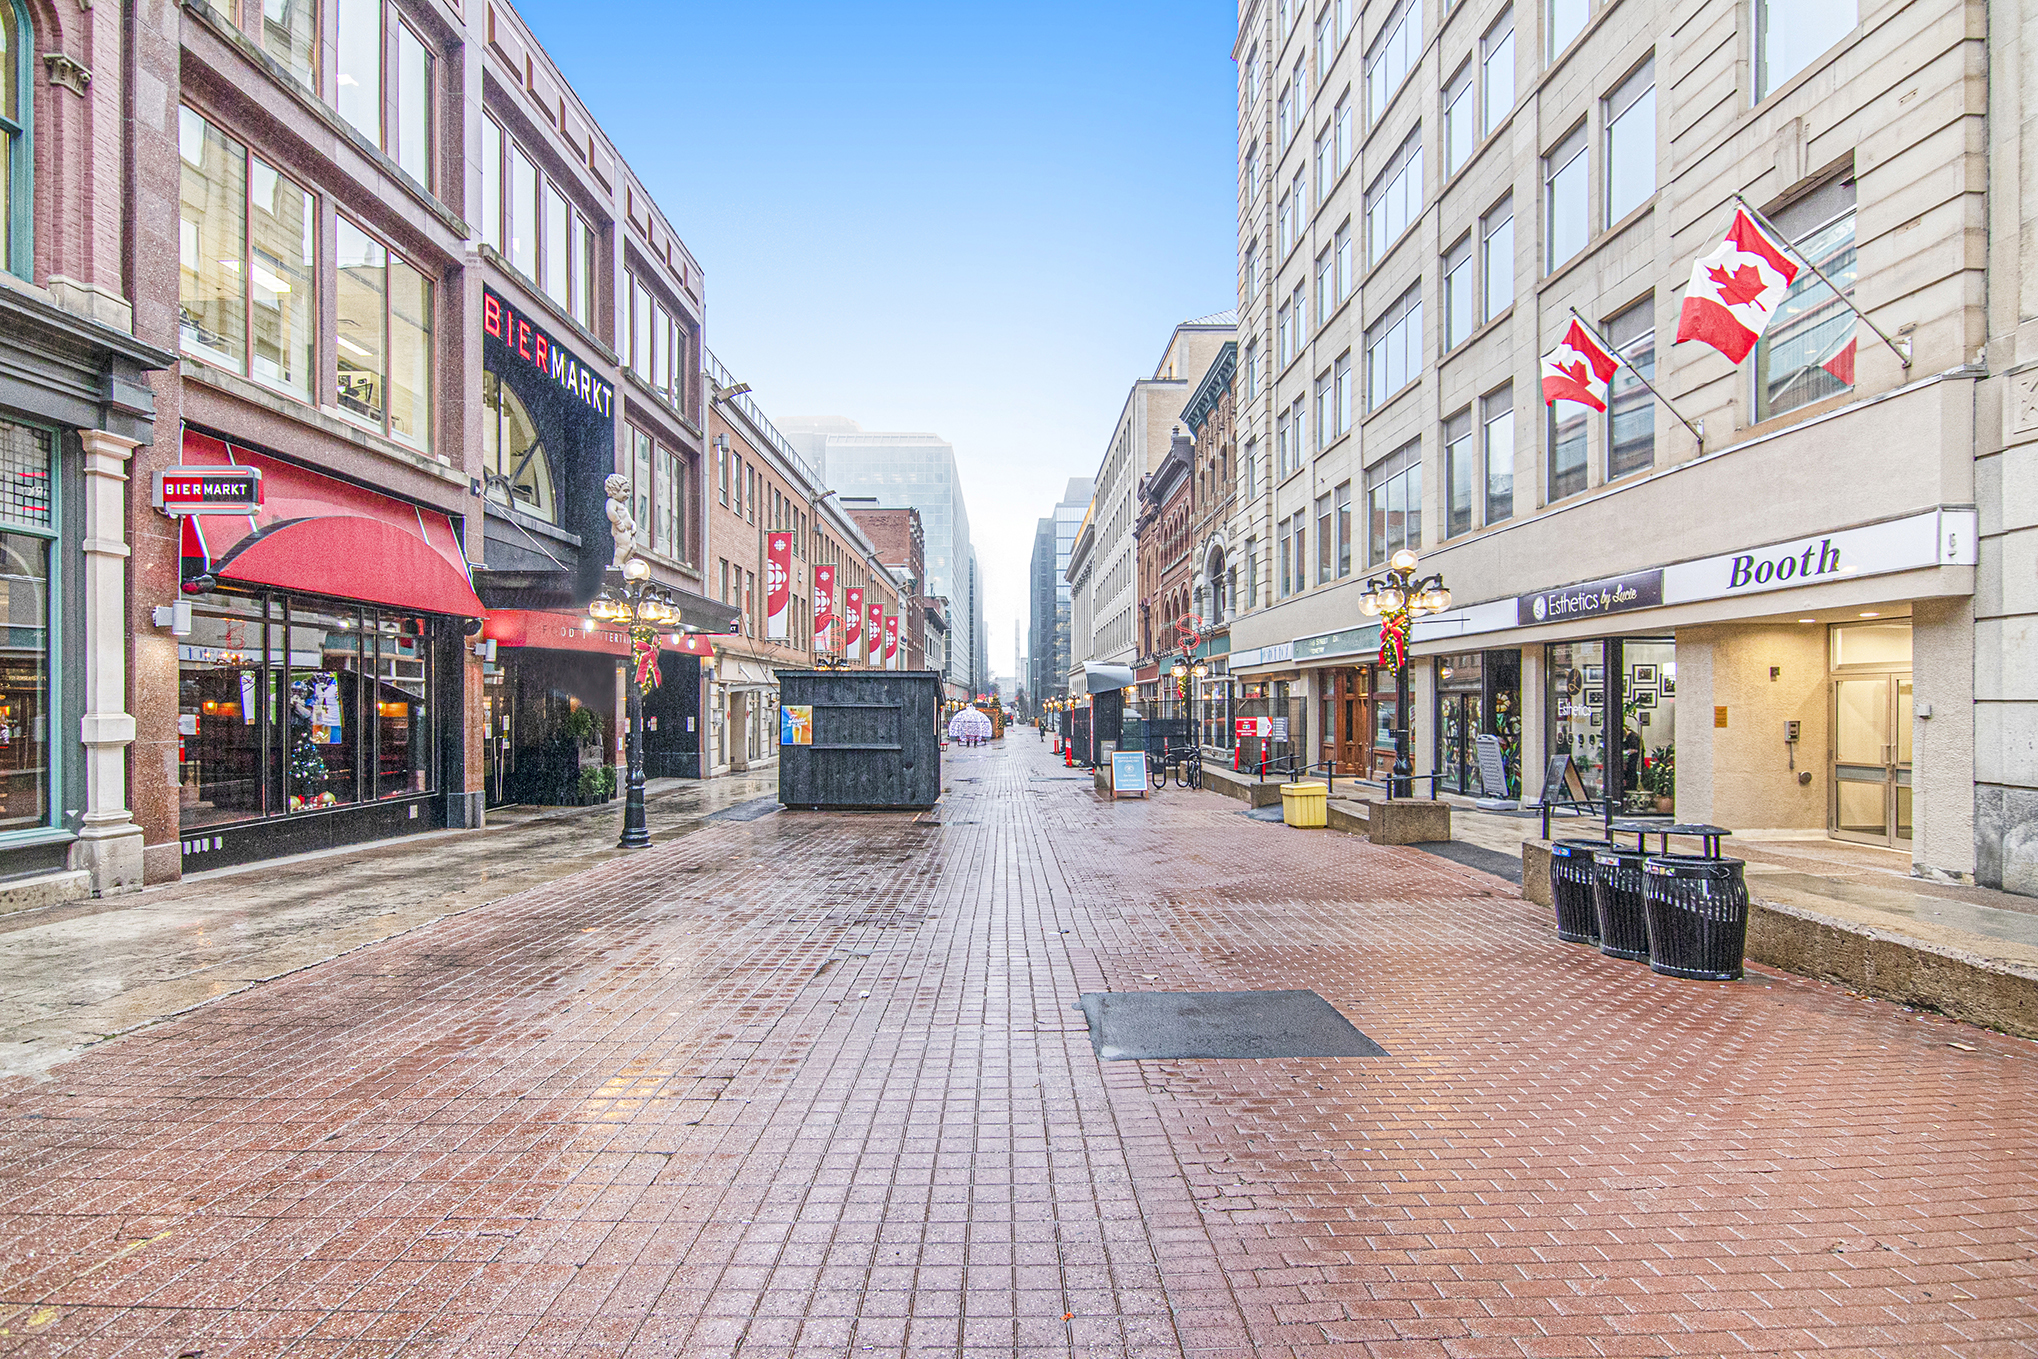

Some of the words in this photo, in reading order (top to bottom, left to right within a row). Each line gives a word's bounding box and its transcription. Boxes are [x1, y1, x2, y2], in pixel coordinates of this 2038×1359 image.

[484, 292, 612, 418] BIERMARKT
[165, 483, 248, 496] BIERMARKT
[1726, 538, 1841, 590] Booth
[1548, 592, 1600, 616] Esthetics
[1600, 587, 1612, 611] by
[1612, 583, 1638, 604] Lucie
[1557, 700, 1592, 717] Esthetics
